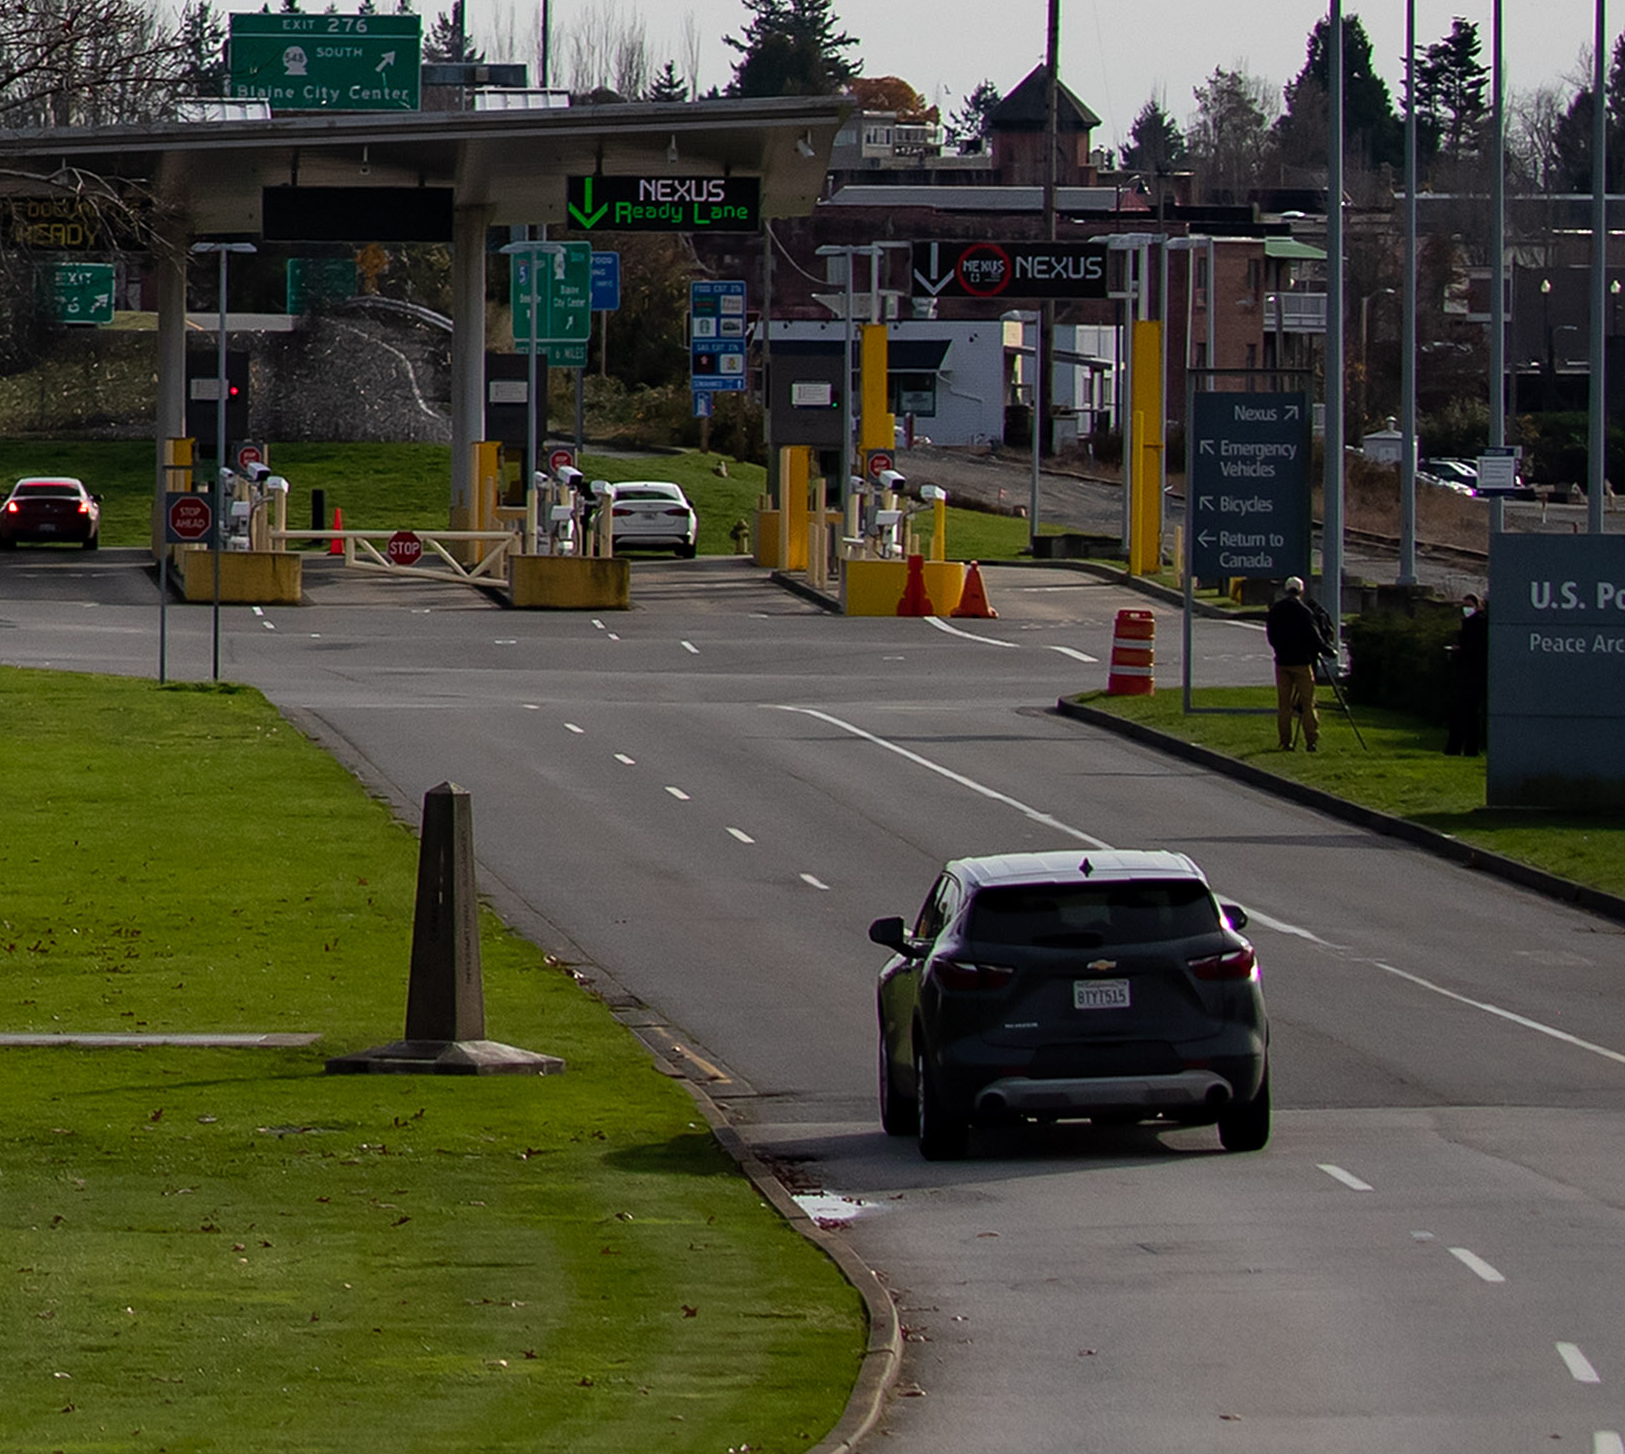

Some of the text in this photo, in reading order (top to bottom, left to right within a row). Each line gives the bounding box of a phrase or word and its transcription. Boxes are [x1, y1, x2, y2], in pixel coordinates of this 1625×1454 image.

[283, 18, 368, 33] EXIT 276
[317, 47, 363, 58] SOUTH
[237, 85, 410, 102] Blaine City Center
[639, 179, 726, 203] NEXUS
[615, 202, 749, 224] Ready Lane
[963, 256, 1103, 279] NEXUS NEXUS
[1234, 405, 1277, 421] Nexus
[1220, 440, 1297, 460] Emergency
[1220, 461, 1276, 477] Vehicles
[180, 507, 201, 517] STOP
[1220, 495, 1274, 516] Bicycles
[176, 519, 206, 529] AHEAD
[1220, 530, 1284, 547] Return to
[389, 542, 421, 556] STOP
[1219, 552, 1273, 569] Canada
[1530, 581, 1586, 610] U.S.
[1530, 633, 1586, 653] Peace
